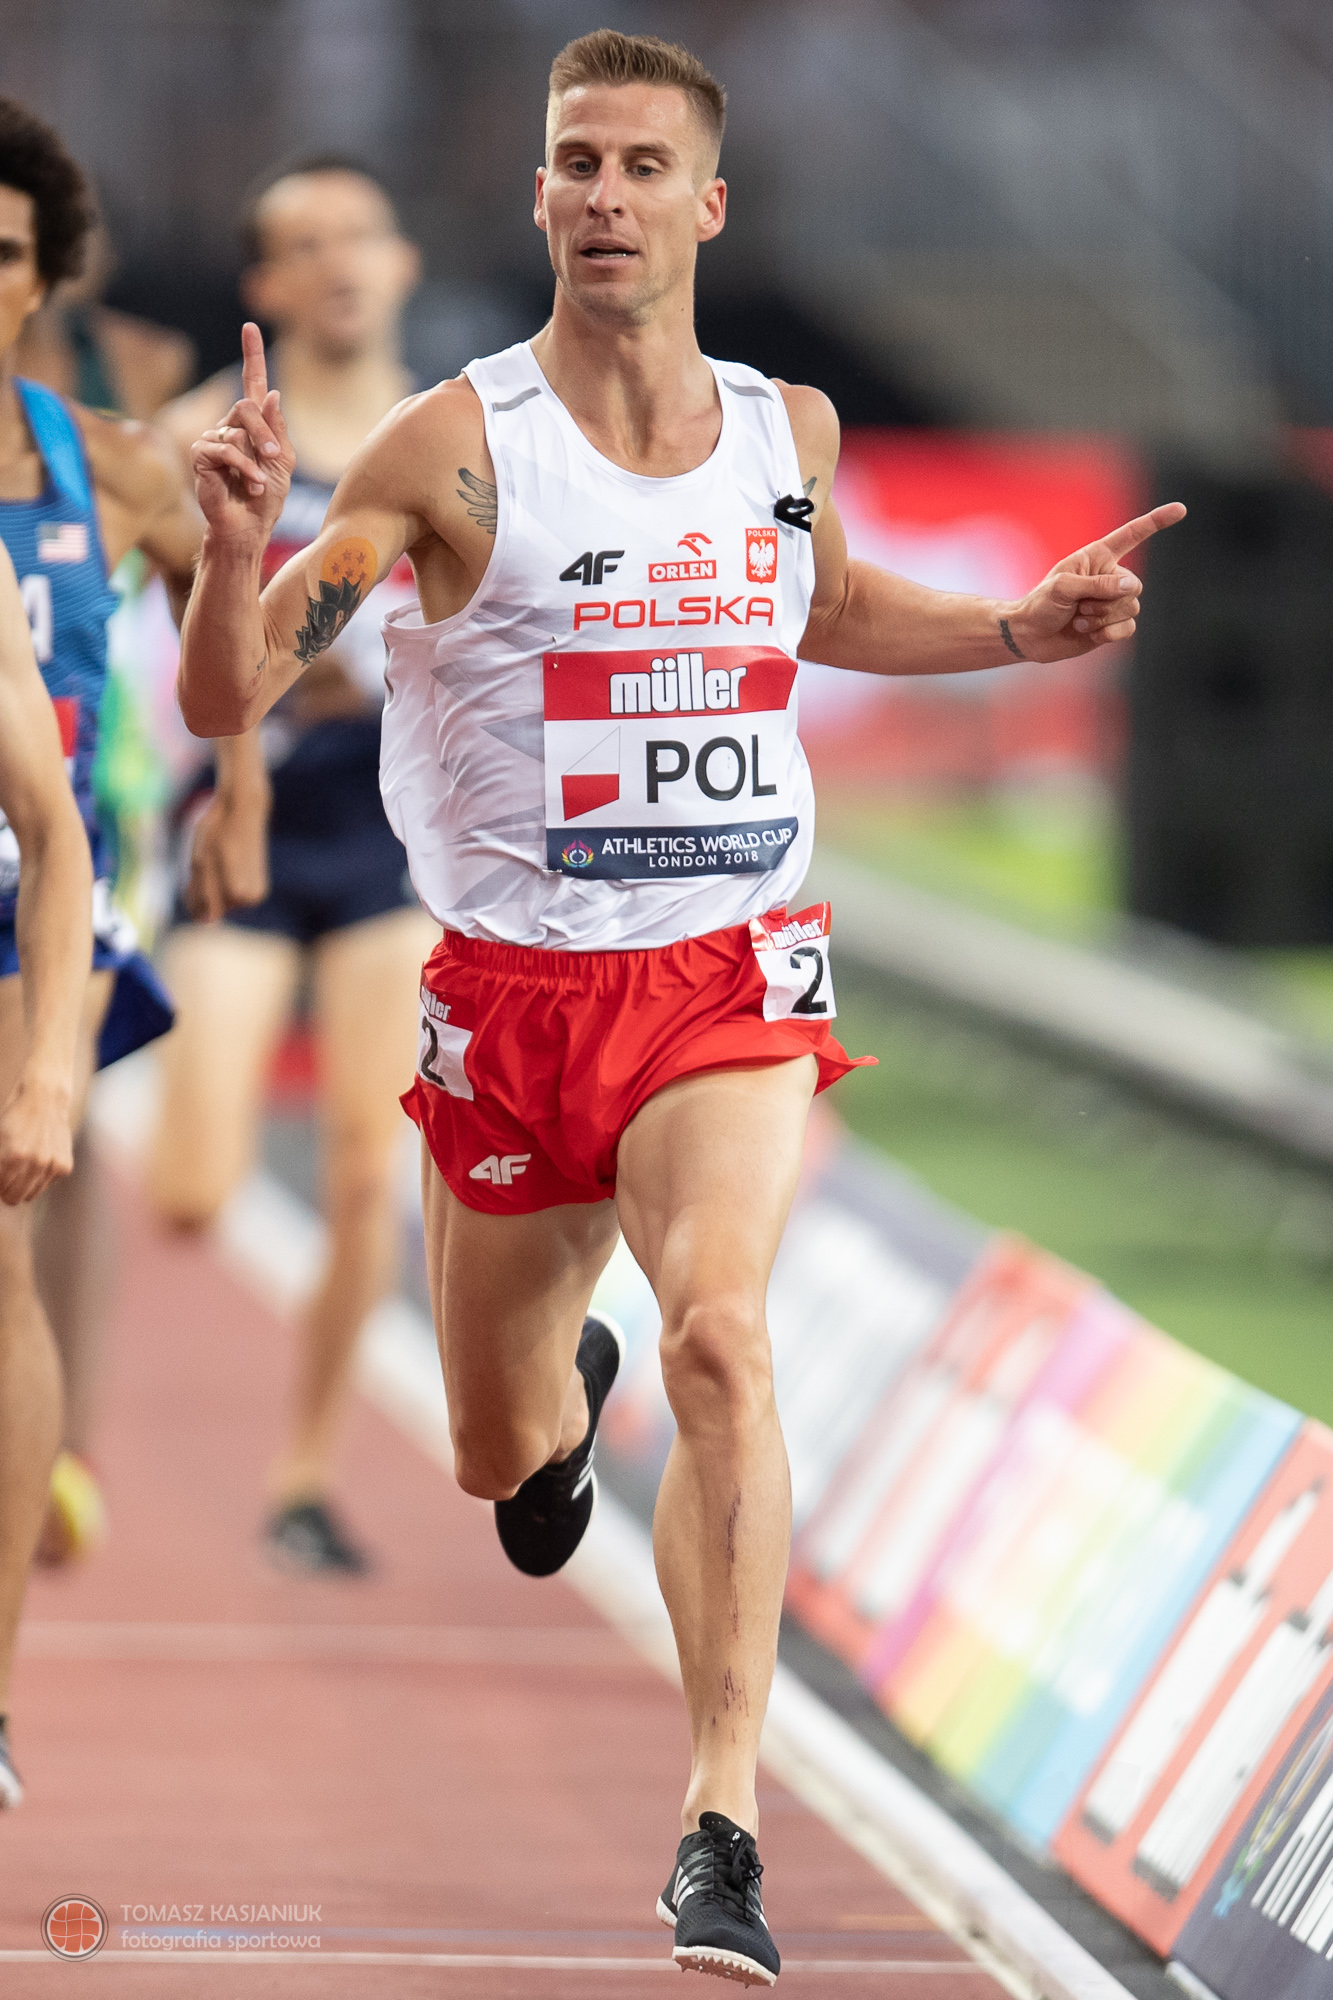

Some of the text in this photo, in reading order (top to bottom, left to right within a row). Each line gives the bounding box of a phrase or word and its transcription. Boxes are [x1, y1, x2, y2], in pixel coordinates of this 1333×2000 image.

[559, 550, 625, 586] 4F
[652, 562, 714, 580] ORLEN
[573, 596, 774, 631] POLSKA
[609, 652, 747, 714] müller
[646, 734, 777, 803] POL
[601, 827, 792, 855] ATHLETICS WORLD CUP
[649, 850, 759, 868] LONDON 2018
[790, 946, 827, 1014] 2
[421, 1015, 446, 1087] 2
[469, 1153, 532, 1185] 4F
